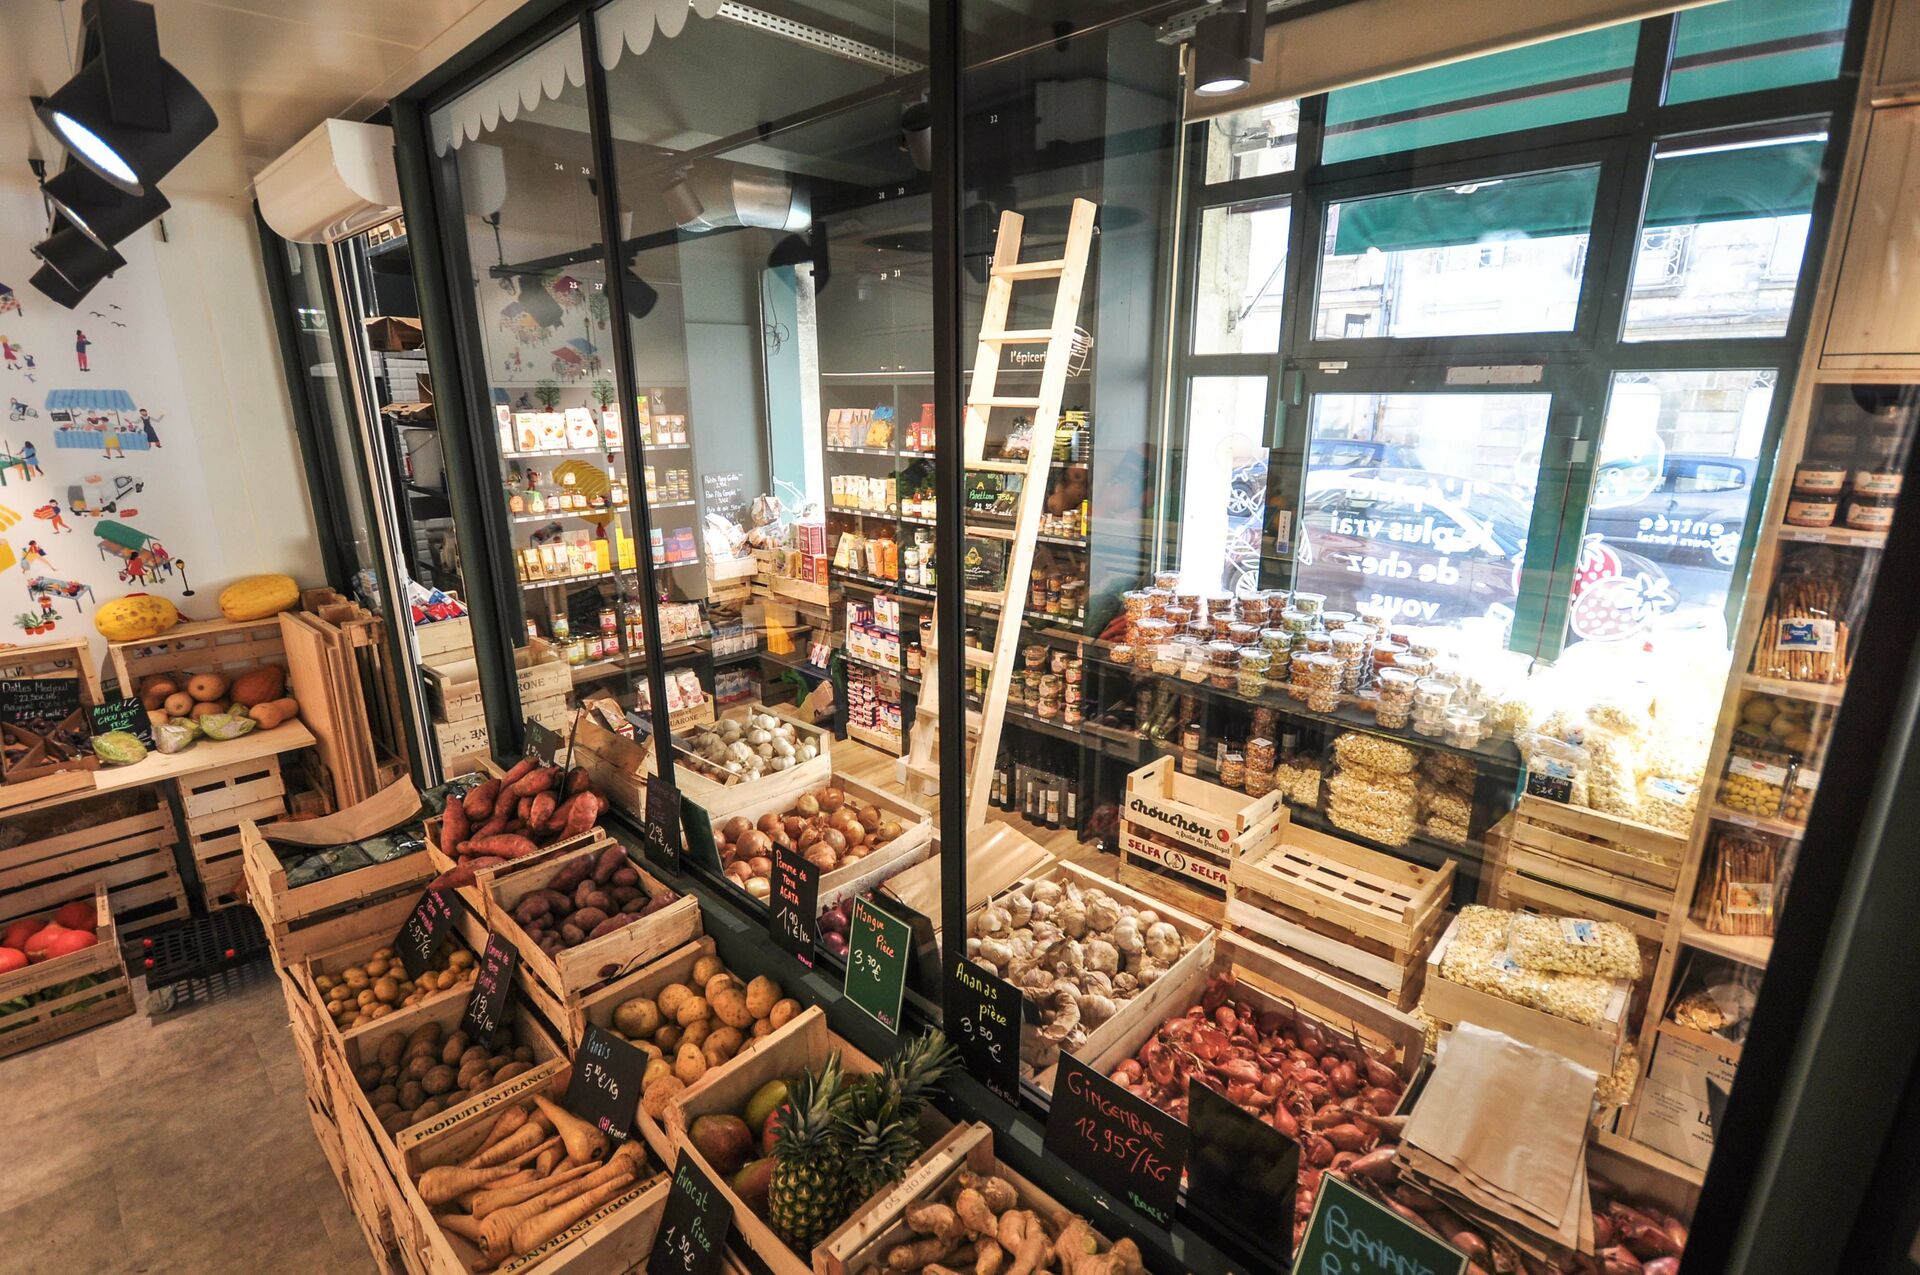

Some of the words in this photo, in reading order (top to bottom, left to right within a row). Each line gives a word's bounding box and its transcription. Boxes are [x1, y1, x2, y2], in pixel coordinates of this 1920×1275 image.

[990, 115, 998, 124] 32
[554, 163, 564, 171] 24
[581, 167, 591, 175] 26
[569, 281, 578, 289] 25
[1010, 351, 1047, 365] l'épiceri
[1127, 838, 1161, 860] SELFA
[1190, 862, 1228, 885] SELFA
[956, 962, 998, 1000] Ananas
[414, 1103, 481, 1142] PRODUIT
[482, 1092, 502, 1110] EN
[502, 1067, 556, 1099] FRANCE
[676, 1165, 709, 1212] Avocat
[593, 1179, 658, 1224] PRODUIT
[571, 1220, 592, 1237] EN
[1324, 1204, 1435, 1275] BANAN
[504, 1233, 569, 1274] FRANCE
